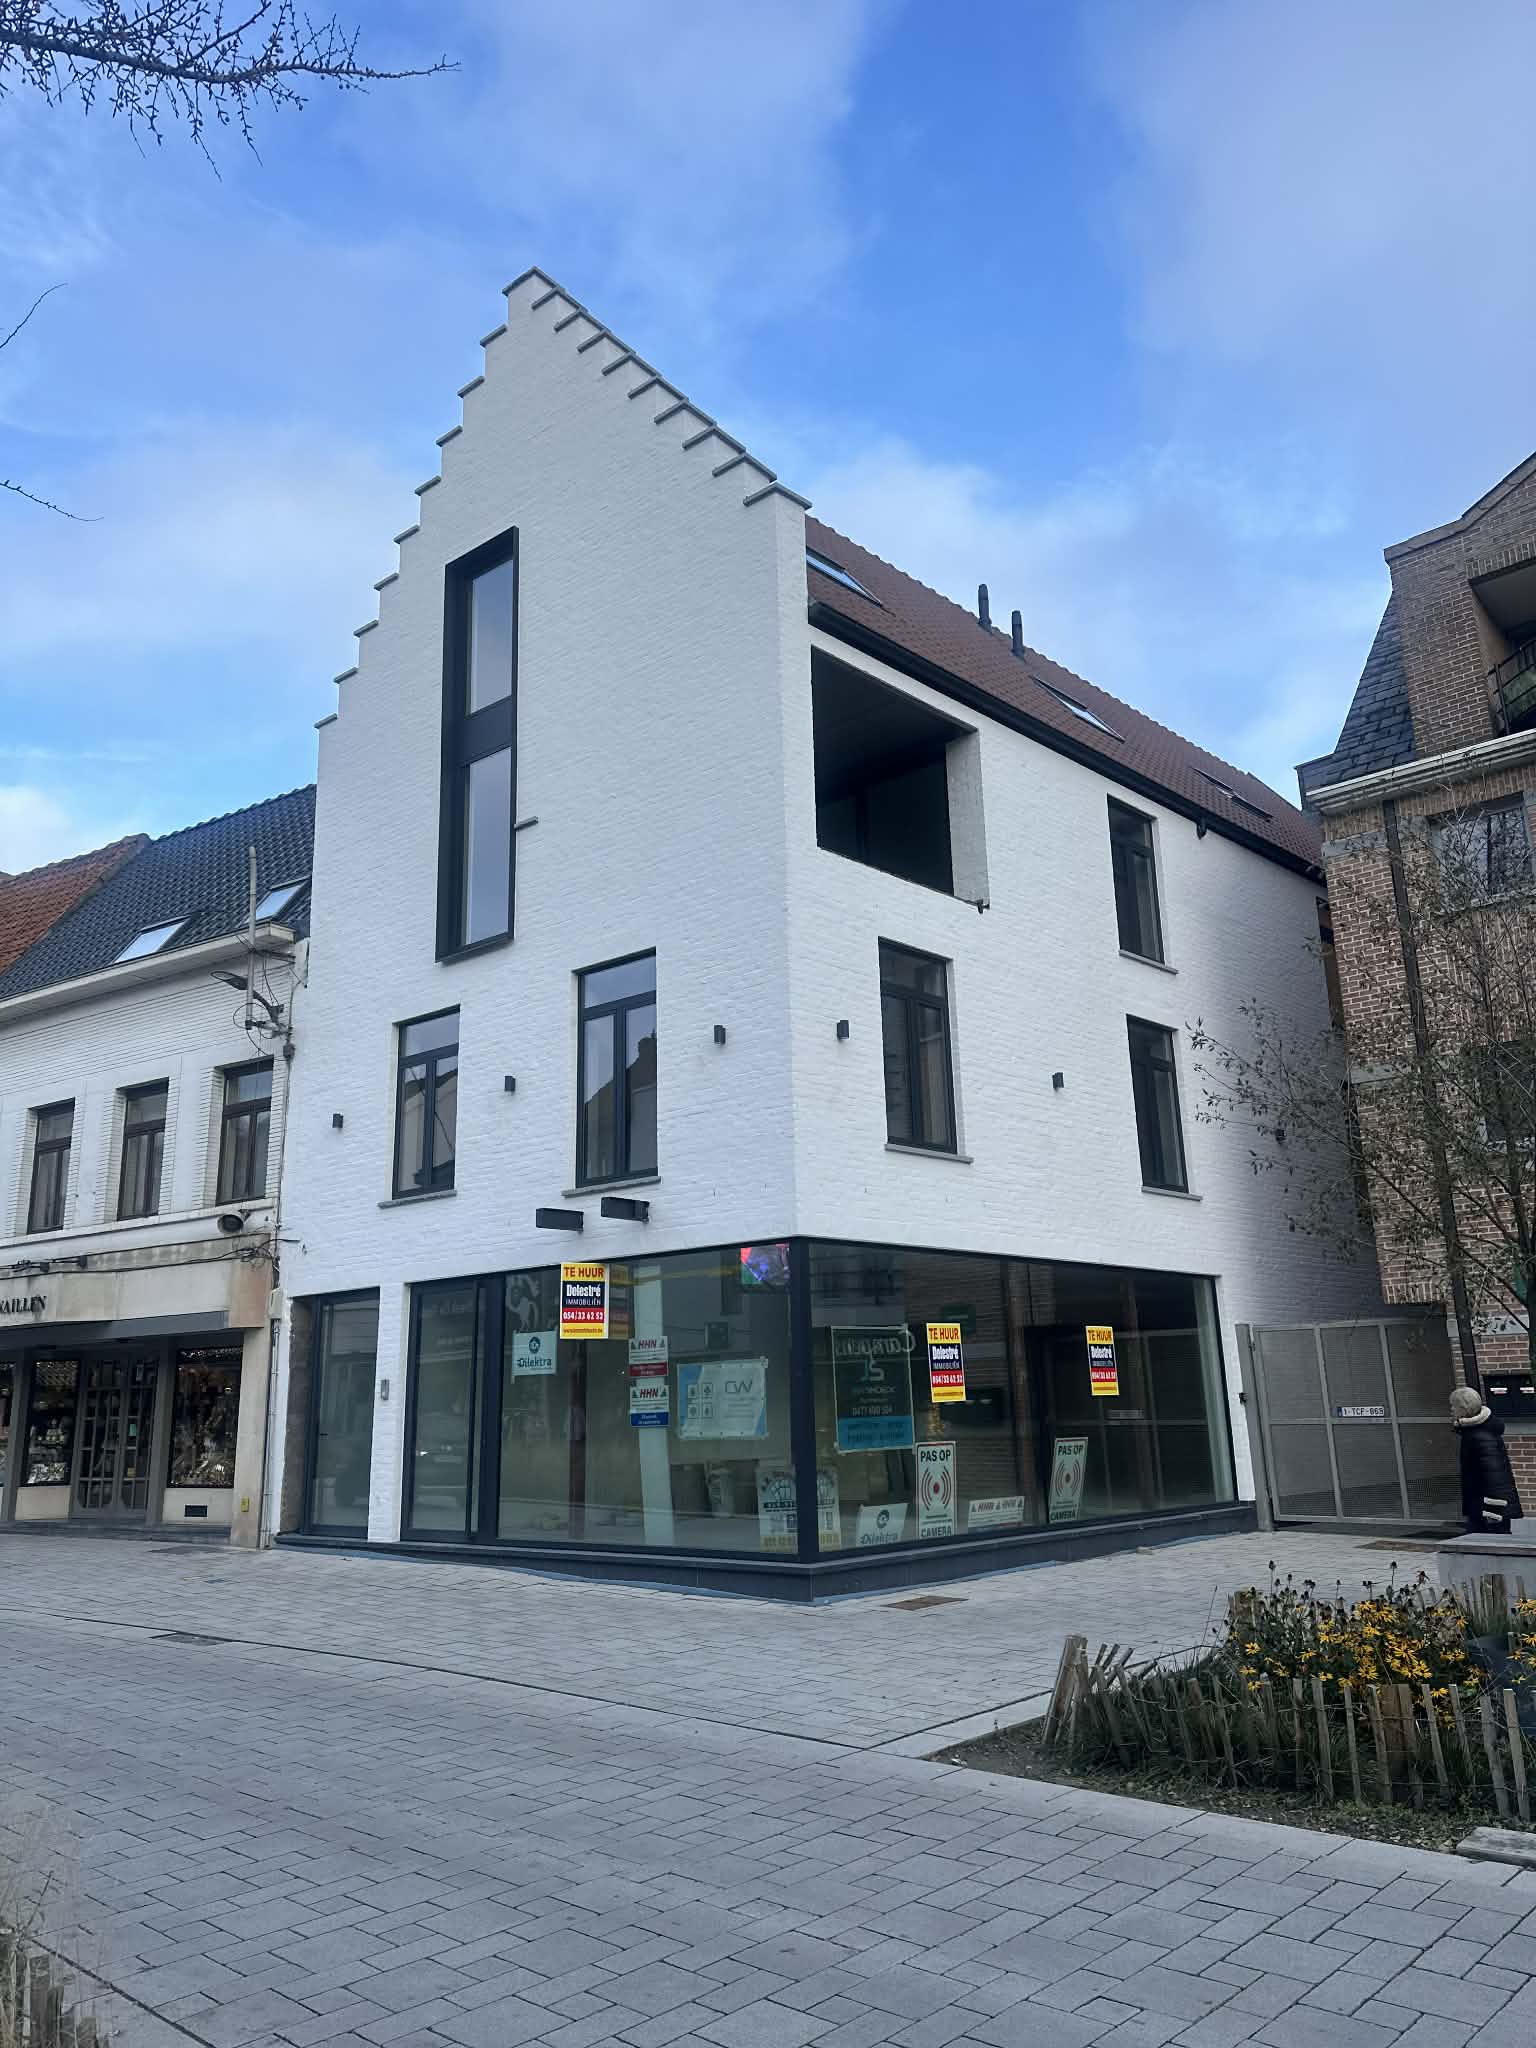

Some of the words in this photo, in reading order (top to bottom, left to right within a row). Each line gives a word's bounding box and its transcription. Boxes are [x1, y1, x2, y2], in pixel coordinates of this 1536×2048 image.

[563, 1266, 576, 1278] TE
[578, 1267, 605, 1278] HUUR
[566, 1284, 601, 1297] Delestré
[928, 1327, 939, 1340] TE
[939, 1327, 960, 1340] HUUR
[639, 1387, 659, 1399] HHN
[920, 1449, 938, 1462] PAS
[939, 1449, 952, 1461] OP
[1057, 1445, 1072, 1456] PAS
[1073, 1445, 1084, 1456] OP
[921, 1526, 952, 1538] CAMERA
